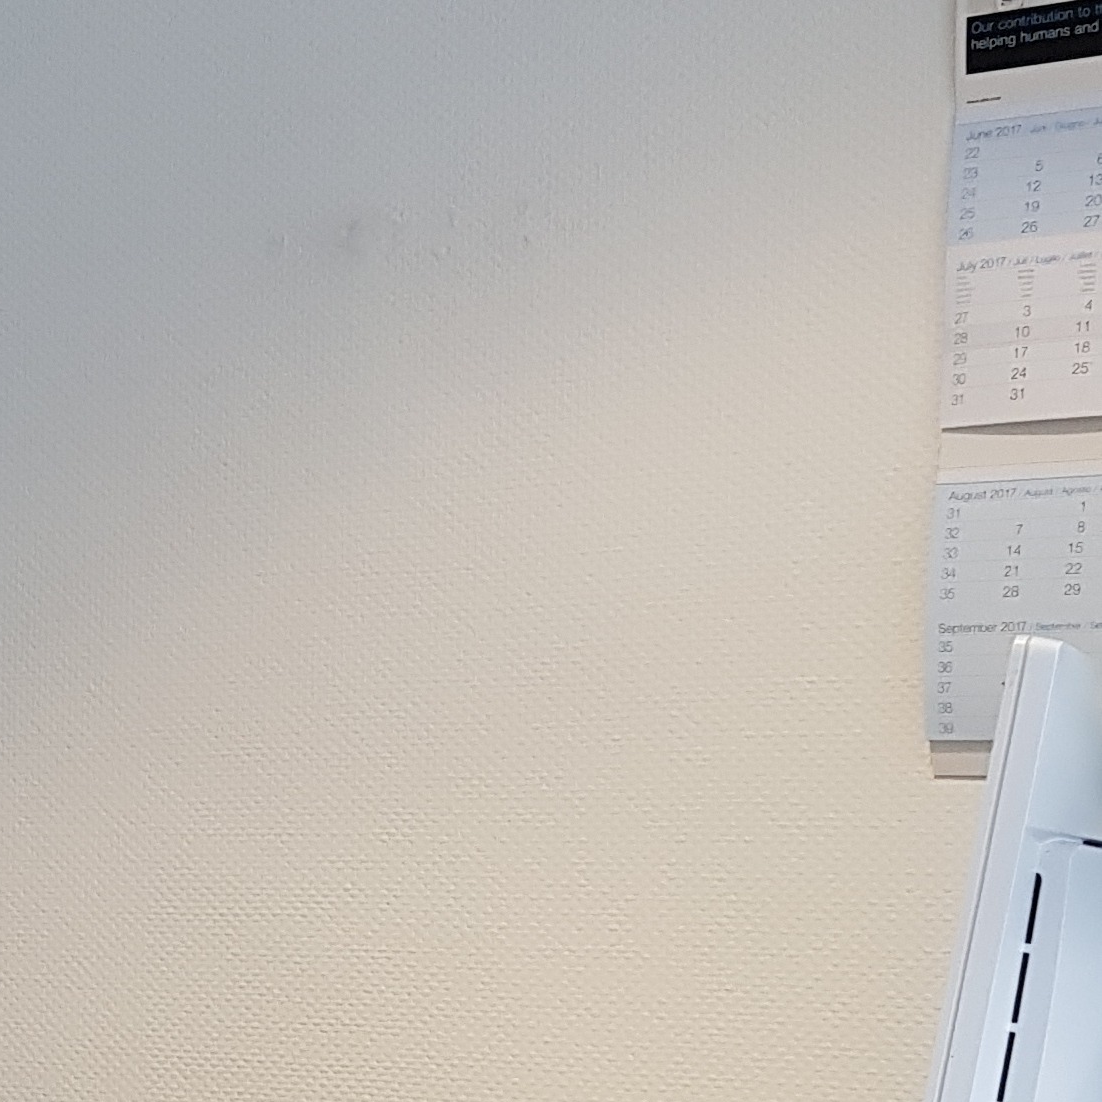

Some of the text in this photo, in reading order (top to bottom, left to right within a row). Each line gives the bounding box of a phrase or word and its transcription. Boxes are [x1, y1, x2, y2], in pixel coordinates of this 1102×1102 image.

[971, 21, 994, 34] Our
[998, 9, 1073, 30] contribution
[1078, 6, 1091, 18] to
[971, 18, 1099, 50] helping humans and
[966, 129, 993, 141] June
[995, 124, 1022, 137] 2017
[964, 146, 980, 159] 22
[1035, 160, 1044, 172] 5
[1026, 180, 1042, 192] 12
[1089, 173, 1102, 186] 13
[1025, 200, 1040, 213] 19
[1085, 193, 1102, 207] 20
[1021, 220, 1038, 234] 26
[1083, 214, 1100, 228] 27
[957, 260, 978, 273] July
[980, 256, 1007, 270] 2017
[954, 299, 1093, 325] 27 3 4
[953, 320, 1090, 345] 28 10 11
[1014, 346, 1029, 358] 17
[1074, 341, 1091, 353] 18
[952, 361, 1089, 385] 30 24 25
[1009, 388, 1025, 400] 31
[948, 491, 987, 502] August
[990, 488, 1017, 499] 2017
[946, 507, 960, 519] 31
[1016, 523, 1023, 535] 7
[1077, 520, 1086, 533] 8
[1007, 544, 1021, 556] 14
[1069, 541, 1084, 553] 15
[1004, 565, 1019, 577] 21
[1065, 562, 1082, 575] 22
[939, 583, 1081, 600] 35 28 29
[938, 622, 997, 634] September
[1000, 621, 1027, 632] 2017
[938, 640, 953, 653] 35
[937, 661, 953, 673] 36
[937, 681, 952, 694] 37
[937, 702, 953, 714] 38
